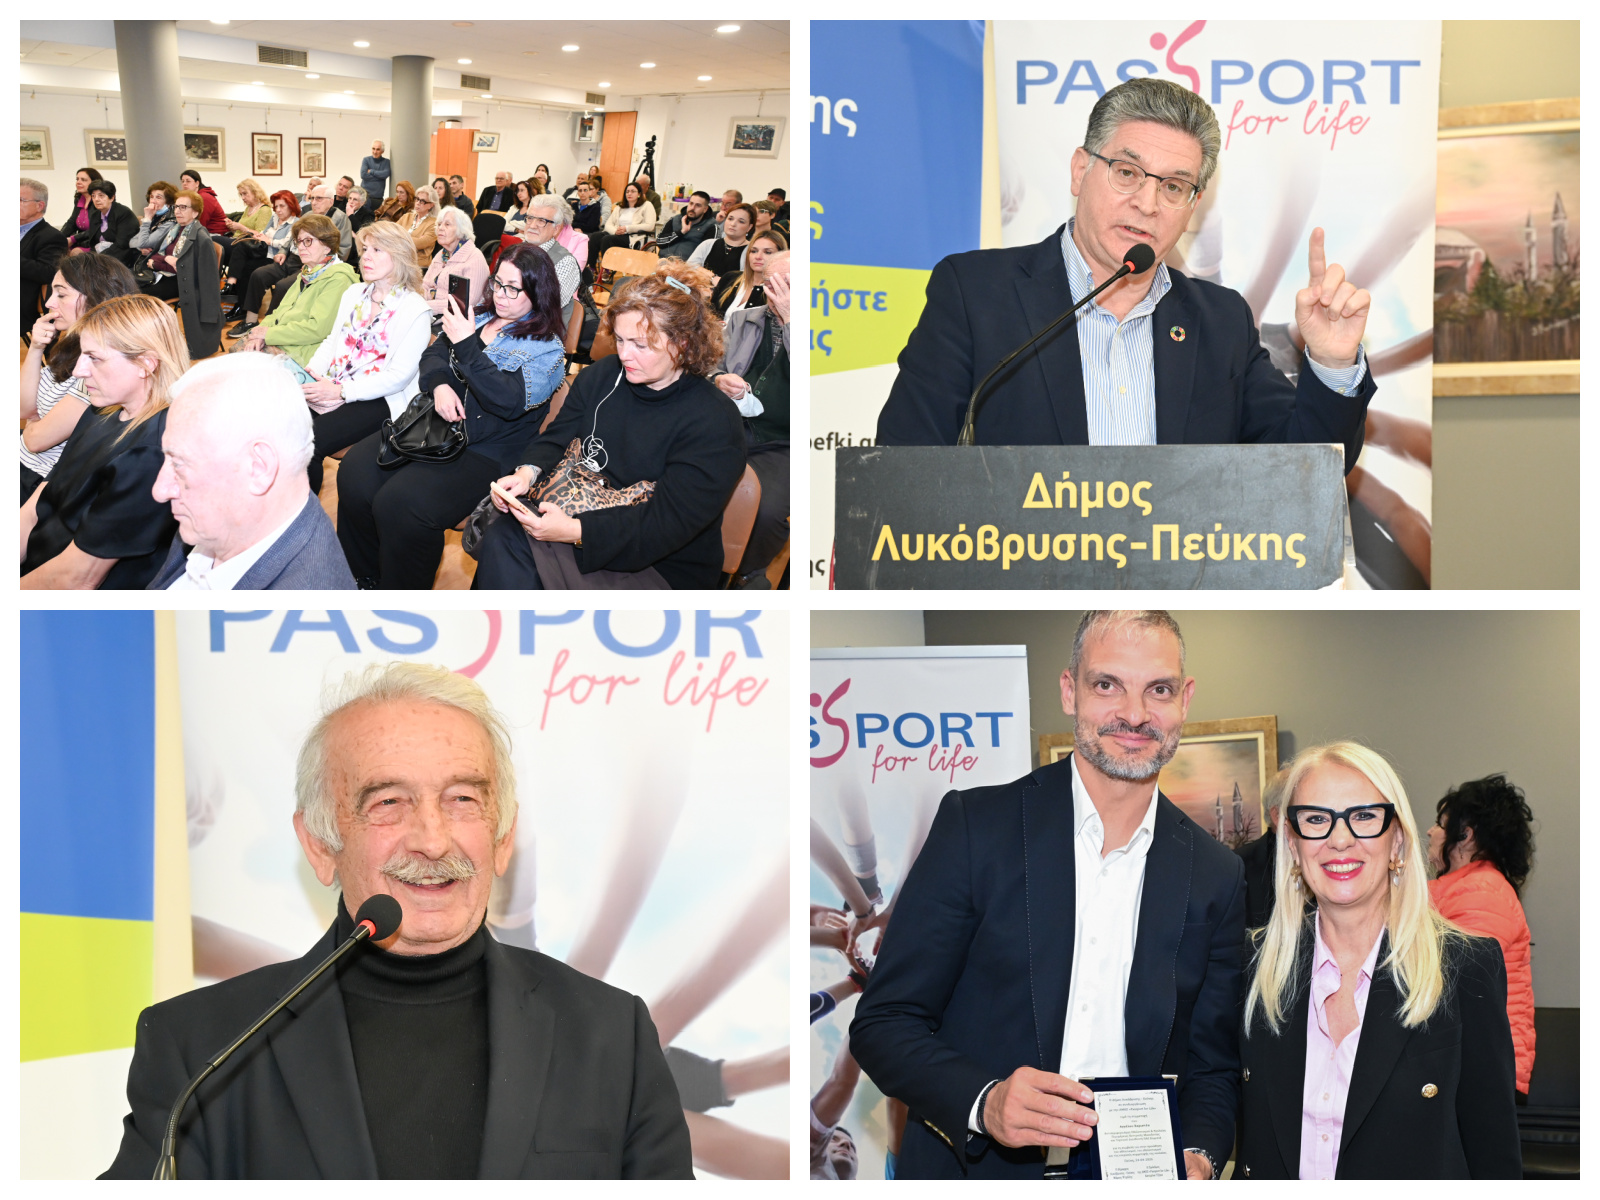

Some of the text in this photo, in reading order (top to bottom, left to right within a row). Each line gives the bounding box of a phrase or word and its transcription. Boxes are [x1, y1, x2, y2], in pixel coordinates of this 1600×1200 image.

[1225, 100, 1371, 151] for life
[1022, 471, 1153, 517] Δήμος
[871, 523, 1308, 570] Λυκόβρυσης-Πεύκης
[540, 648, 770, 733] for life
[871, 743, 980, 784] for life
